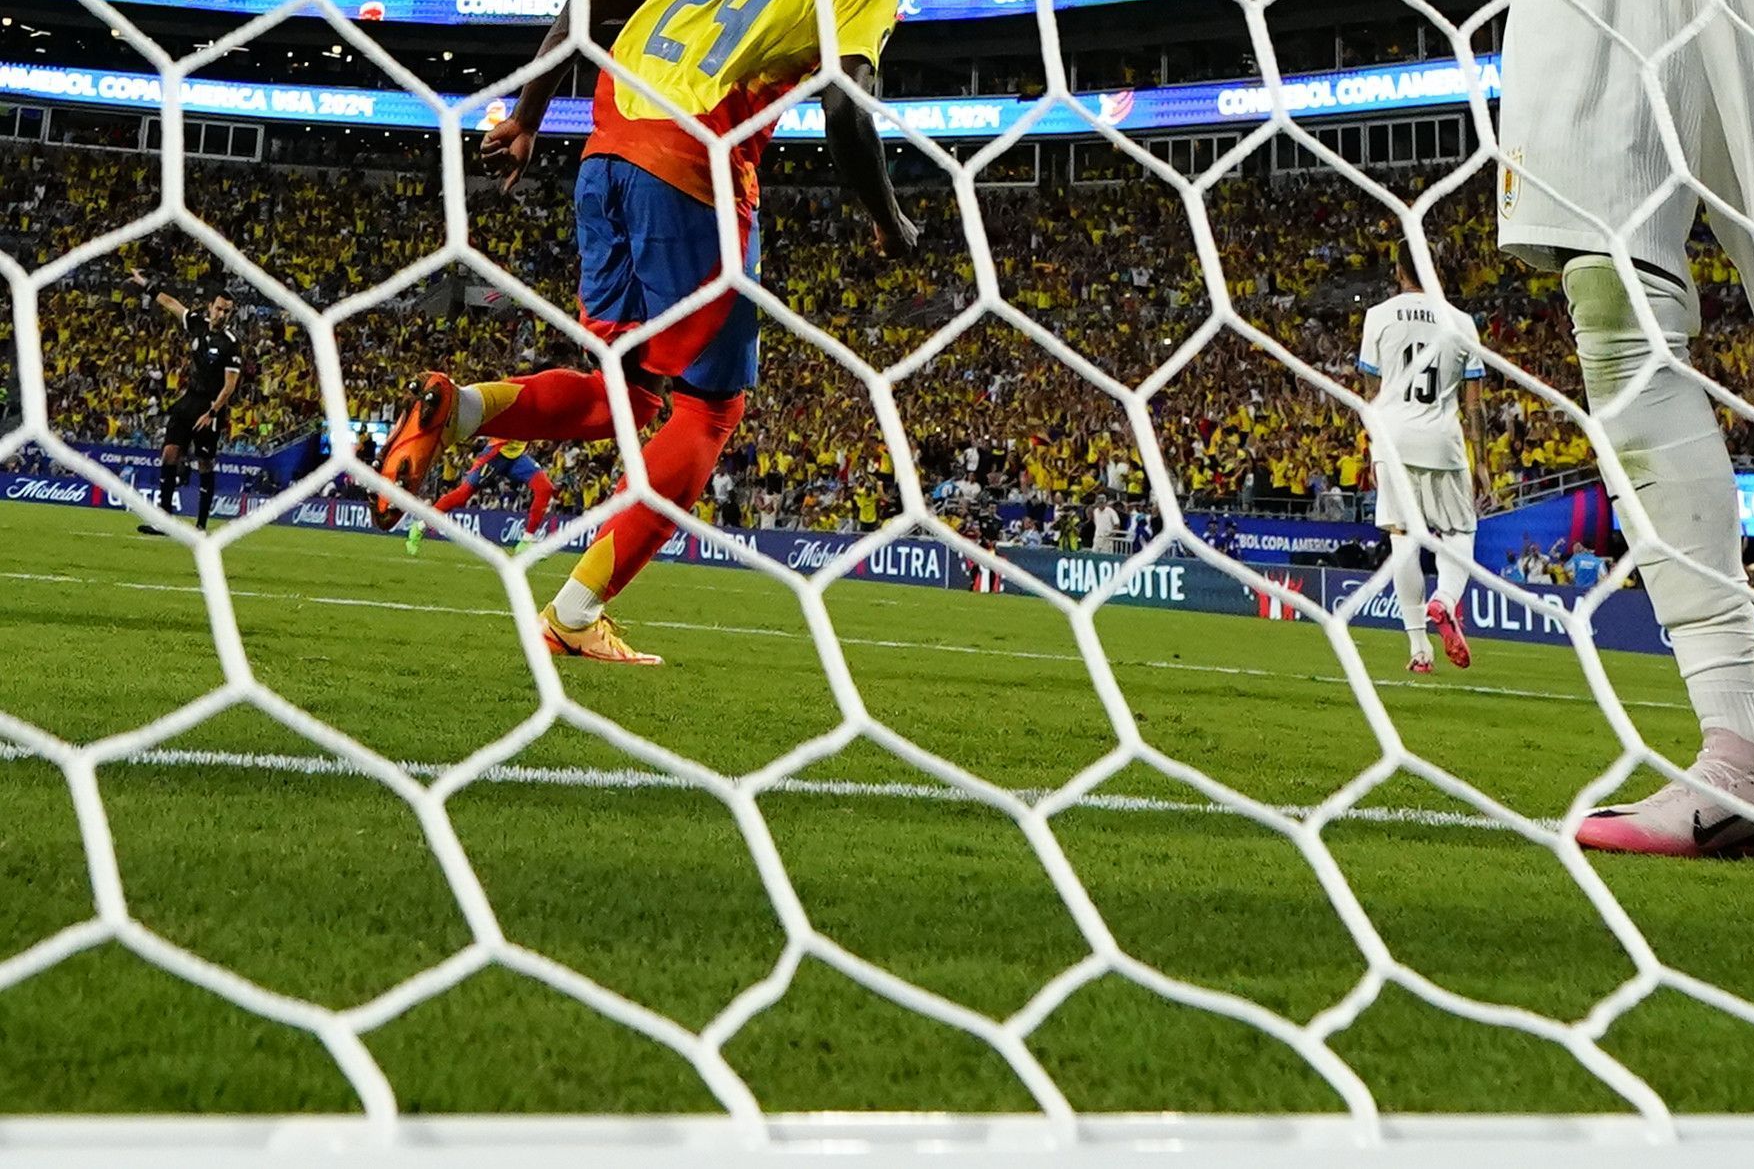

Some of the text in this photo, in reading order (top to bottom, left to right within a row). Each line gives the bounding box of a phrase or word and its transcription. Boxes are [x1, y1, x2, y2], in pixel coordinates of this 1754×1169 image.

[98, 76, 161, 102] COPA
[271, 89, 315, 114] USA
[318, 94, 376, 116] 2024
[1336, 76, 1397, 104] COPA
[7, 478, 90, 502] Michelob
[870, 545, 941, 579] ULTRA
